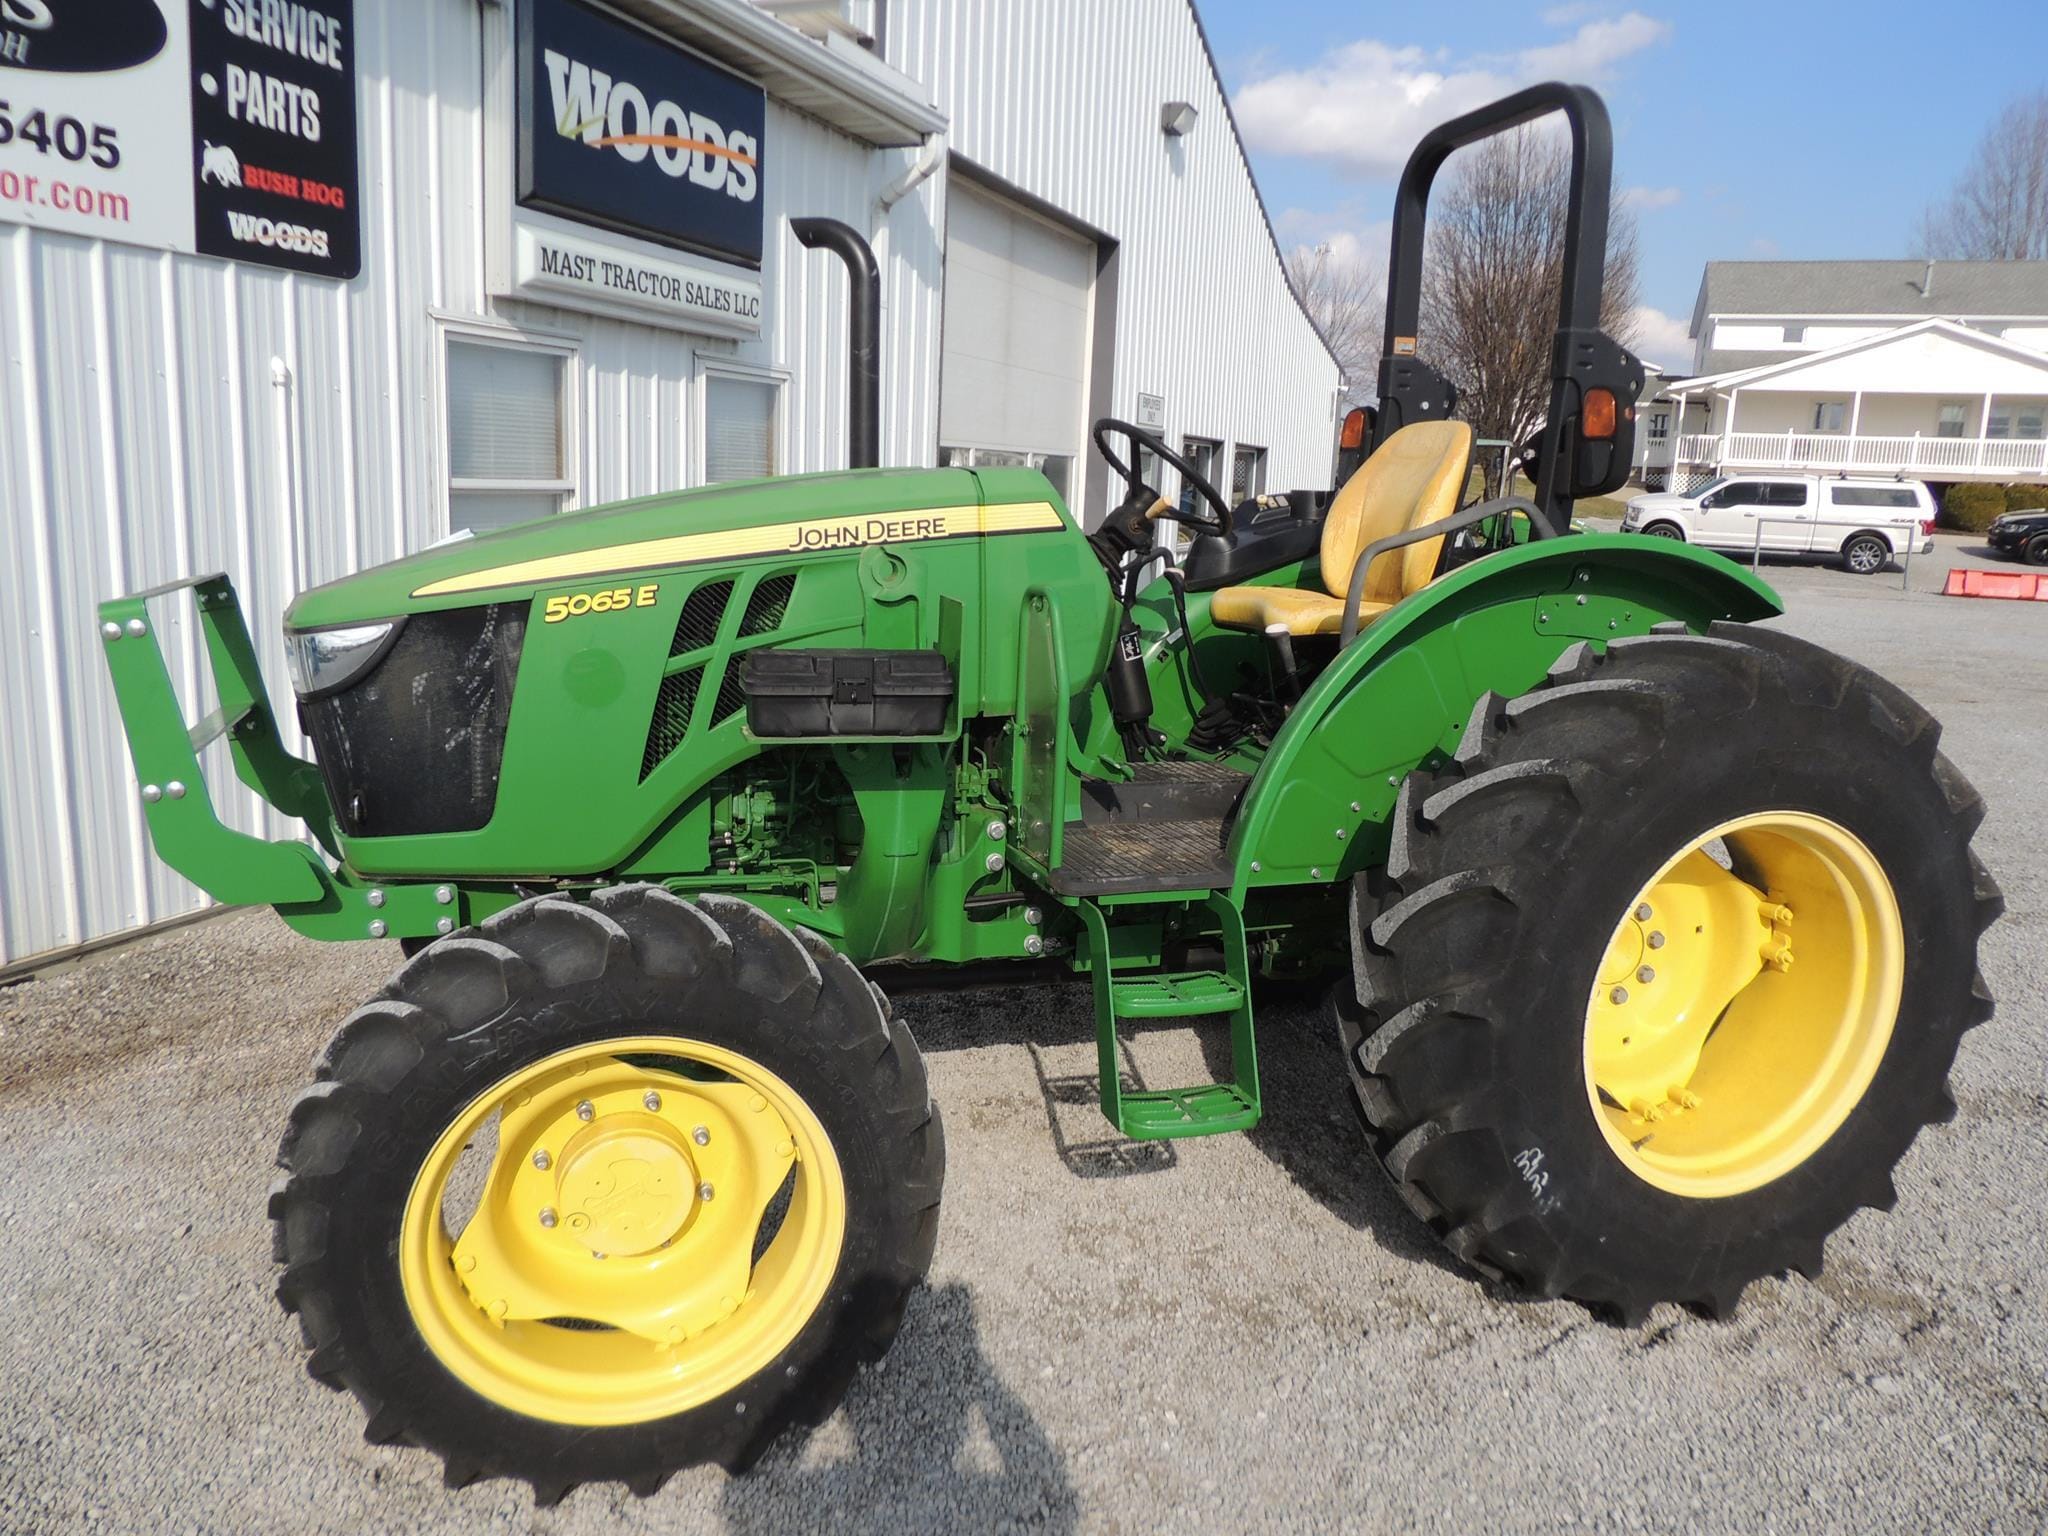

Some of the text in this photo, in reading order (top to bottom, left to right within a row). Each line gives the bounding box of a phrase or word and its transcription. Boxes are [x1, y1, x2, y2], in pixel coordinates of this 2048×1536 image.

[224, 0, 343, 71] SERVICE
[226, 63, 321, 142] PARTS
[544, 47, 757, 202] WOODS
[243, 163, 345, 209] BUSH HOG
[227, 210, 330, 258] WOODS
[540, 246, 760, 319] MAST TRACTOR SALES LLC
[789, 517, 946, 548] JOHN DEERE
[544, 583, 659, 623] 5065 E
